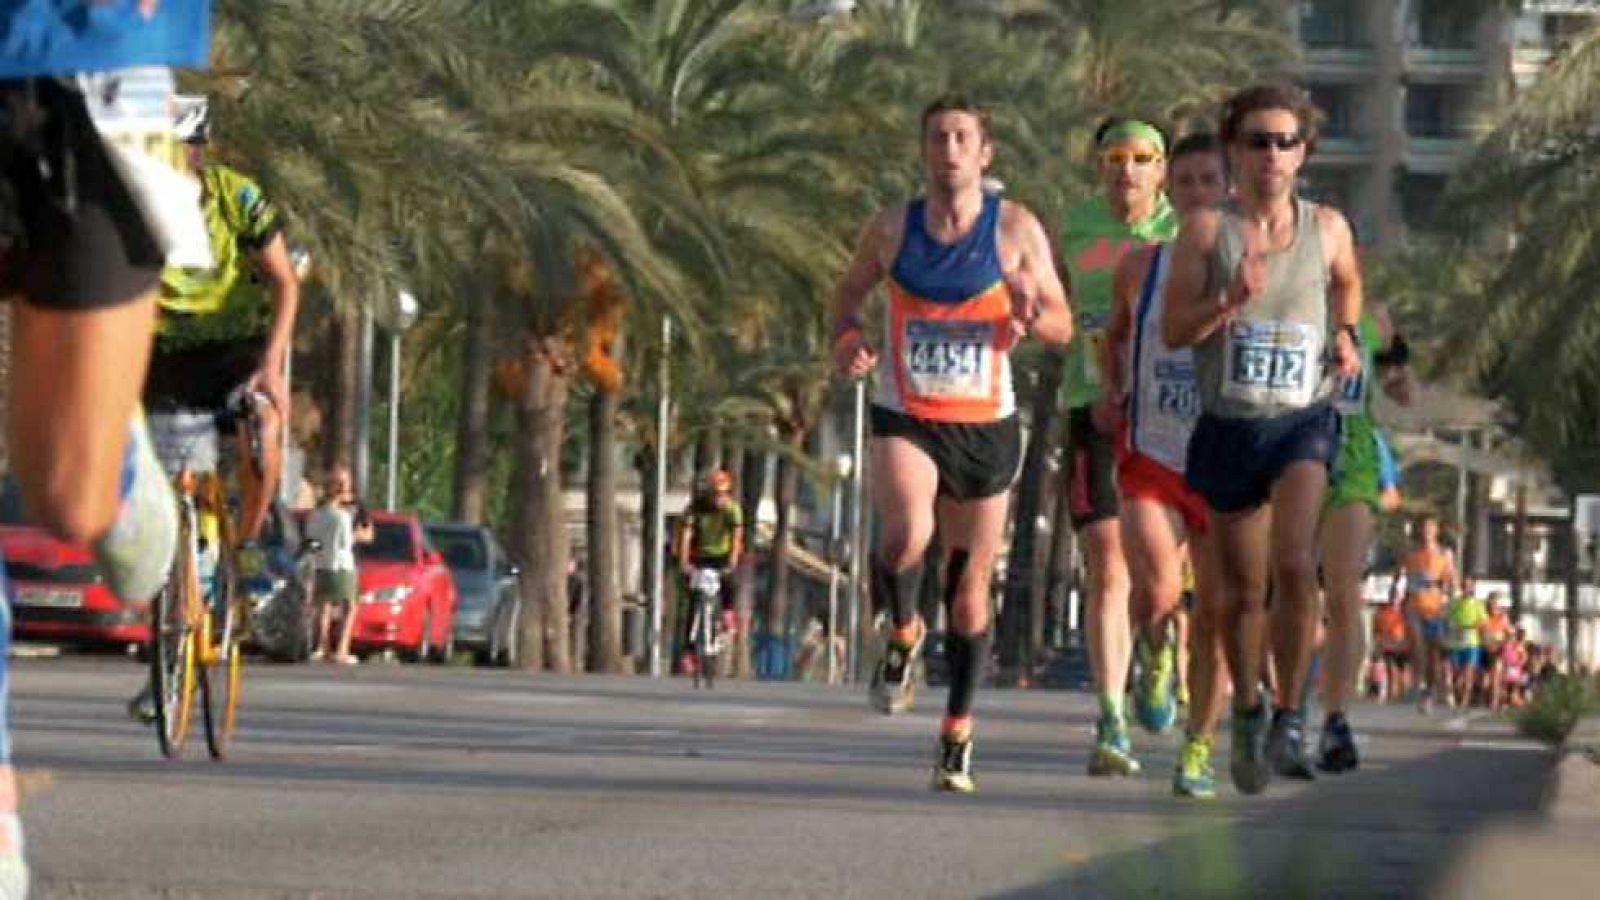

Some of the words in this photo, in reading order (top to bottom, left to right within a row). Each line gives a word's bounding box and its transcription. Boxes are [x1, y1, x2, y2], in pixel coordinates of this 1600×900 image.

[910, 341, 979, 375] 4454
[1240, 348, 1302, 386] 5312
[1162, 383, 1198, 416] 20
